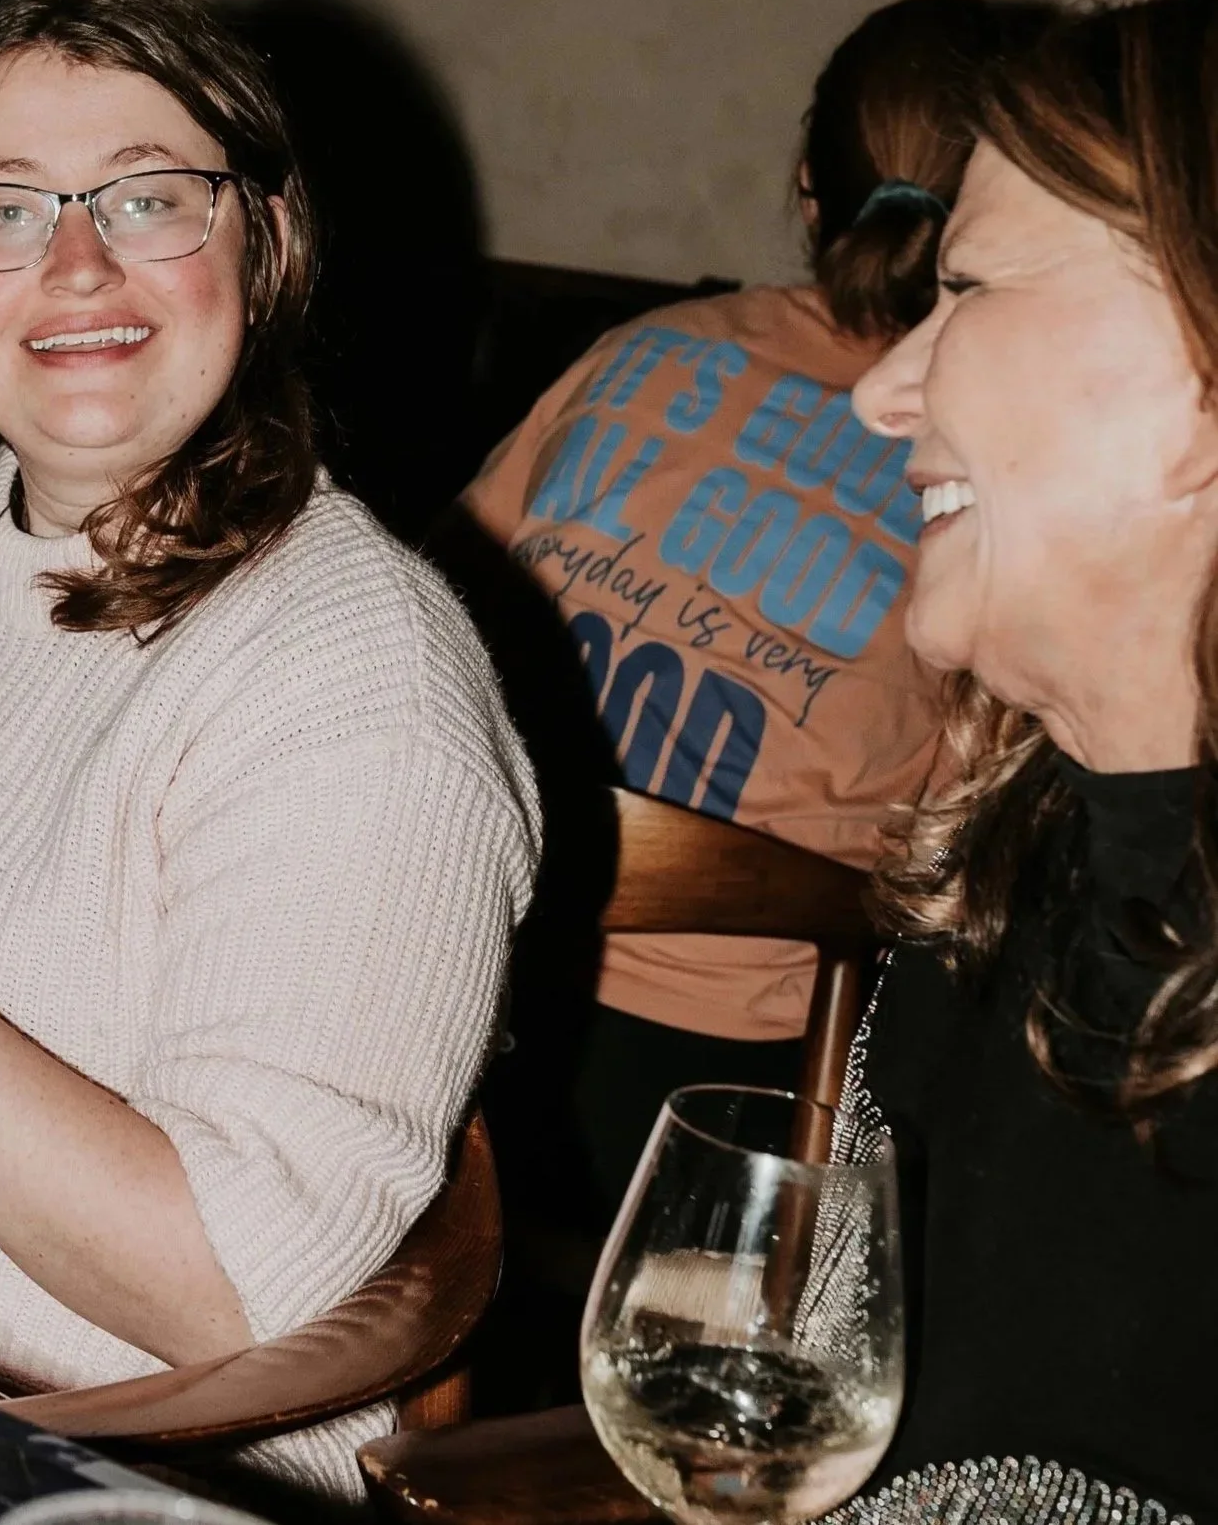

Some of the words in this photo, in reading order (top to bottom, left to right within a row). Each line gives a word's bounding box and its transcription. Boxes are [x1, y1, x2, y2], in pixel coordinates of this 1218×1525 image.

[587, 327, 749, 435] IT'S
[527, 413, 666, 543] ALL
[658, 466, 906, 659] GOOD
[677, 583, 731, 648] is
[745, 630, 839, 728] very
